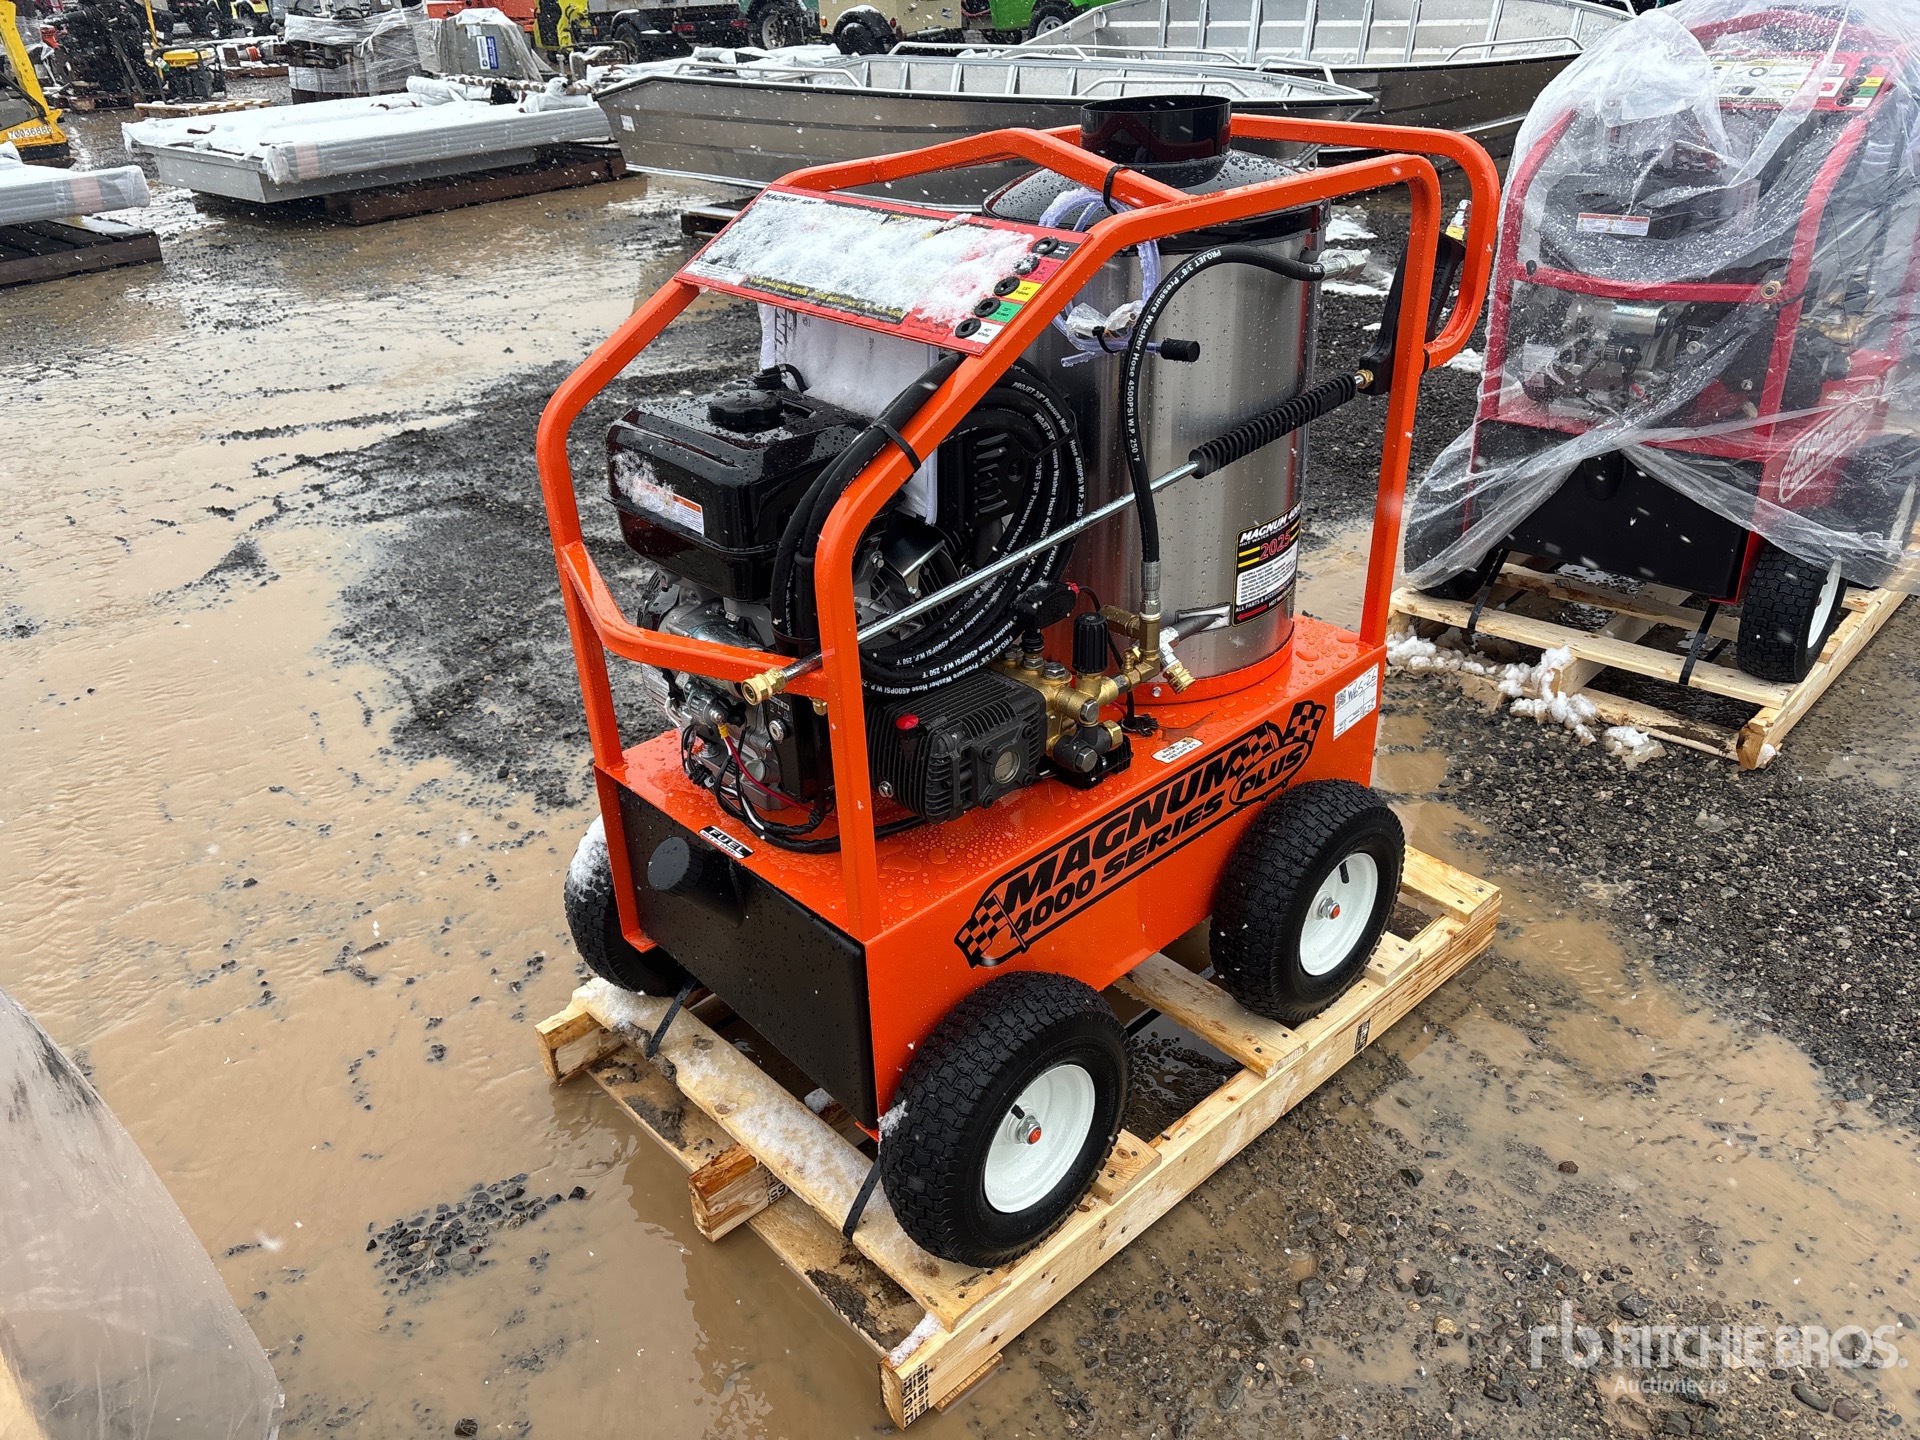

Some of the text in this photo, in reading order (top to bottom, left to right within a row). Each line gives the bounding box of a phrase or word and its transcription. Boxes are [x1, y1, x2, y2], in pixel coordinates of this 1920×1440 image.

[1195, 249, 1222, 267] PROJET
[1151, 275, 1180, 314] Pressure
[1134, 314, 1155, 352] Washer
[1128, 352, 1140, 377] Hose
[1011, 381, 1035, 394] PROJET
[1042, 397, 1062, 420] Pressure
[1126, 380, 1135, 417] 4500PSI
[1032, 412, 1051, 433] PROJET
[1058, 417, 1071, 435] Wash
[1127, 417, 1136, 437] W.P.
[1069, 438, 1079, 458] Hose
[1129, 437, 1139, 453] 250
[1075, 457, 1085, 486] 4500PSI
[1050, 469, 1060, 496] Washer
[1019, 494, 1038, 525] Pressure
[1047, 496, 1057, 517] Hose
[1076, 503, 1085, 517] 250
[1006, 524, 1024, 552] Washer
[1240, 513, 1288, 544] MAGNUM
[1239, 538, 1252, 548] HOT
[1252, 533, 1270, 544] WATER
[1259, 531, 1292, 562] 2025
[1021, 567, 1033, 583] 250
[1235, 605, 1246, 613] ALL
[1245, 599, 1261, 610] PARTS
[964, 608, 985, 630] Washer
[949, 627, 965, 642] Hose
[993, 619, 1017, 642] Washer
[926, 638, 950, 660] 4500PSI
[978, 637, 995, 653] Hose
[990, 634, 1014, 658] PROJET
[901, 656, 913, 666] 250
[954, 648, 979, 668] 4500PSI
[928, 667, 941, 678] 250
[952, 661, 979, 679] Pressure
[884, 686, 911, 695] 4500PSI
[911, 682, 929, 692] Hose
[928, 675, 953, 689] Washer
[1236, 747, 1306, 801] PLUS
[1003, 742, 1248, 915] MAGNUM
[708, 829, 744, 856] FUEL
[1014, 792, 1227, 935] 4000 SERIES
